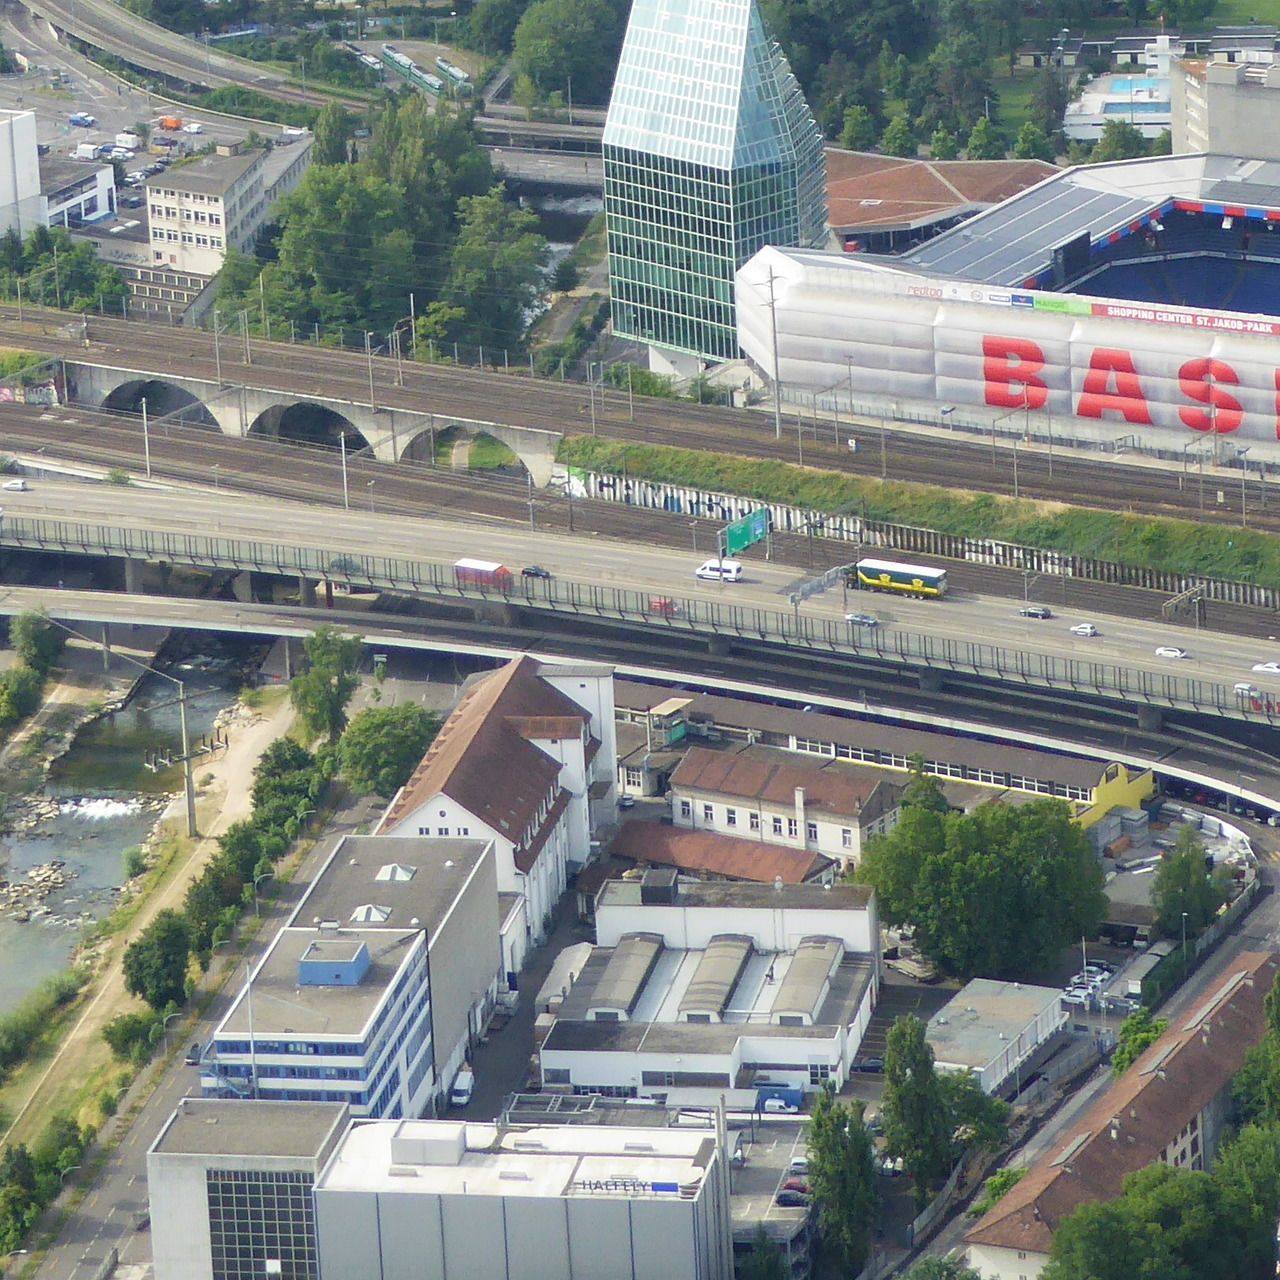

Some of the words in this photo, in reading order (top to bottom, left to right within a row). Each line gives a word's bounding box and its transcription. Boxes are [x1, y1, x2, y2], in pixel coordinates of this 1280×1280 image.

[1107, 306, 1155, 320] SHOPPING
[1155, 312, 1193, 324] CENTER
[1196, 315, 1211, 326] ST.
[1212, 318, 1273, 333] JAKOB-PARK
[582, 1180, 649, 1193] HAEFELY
